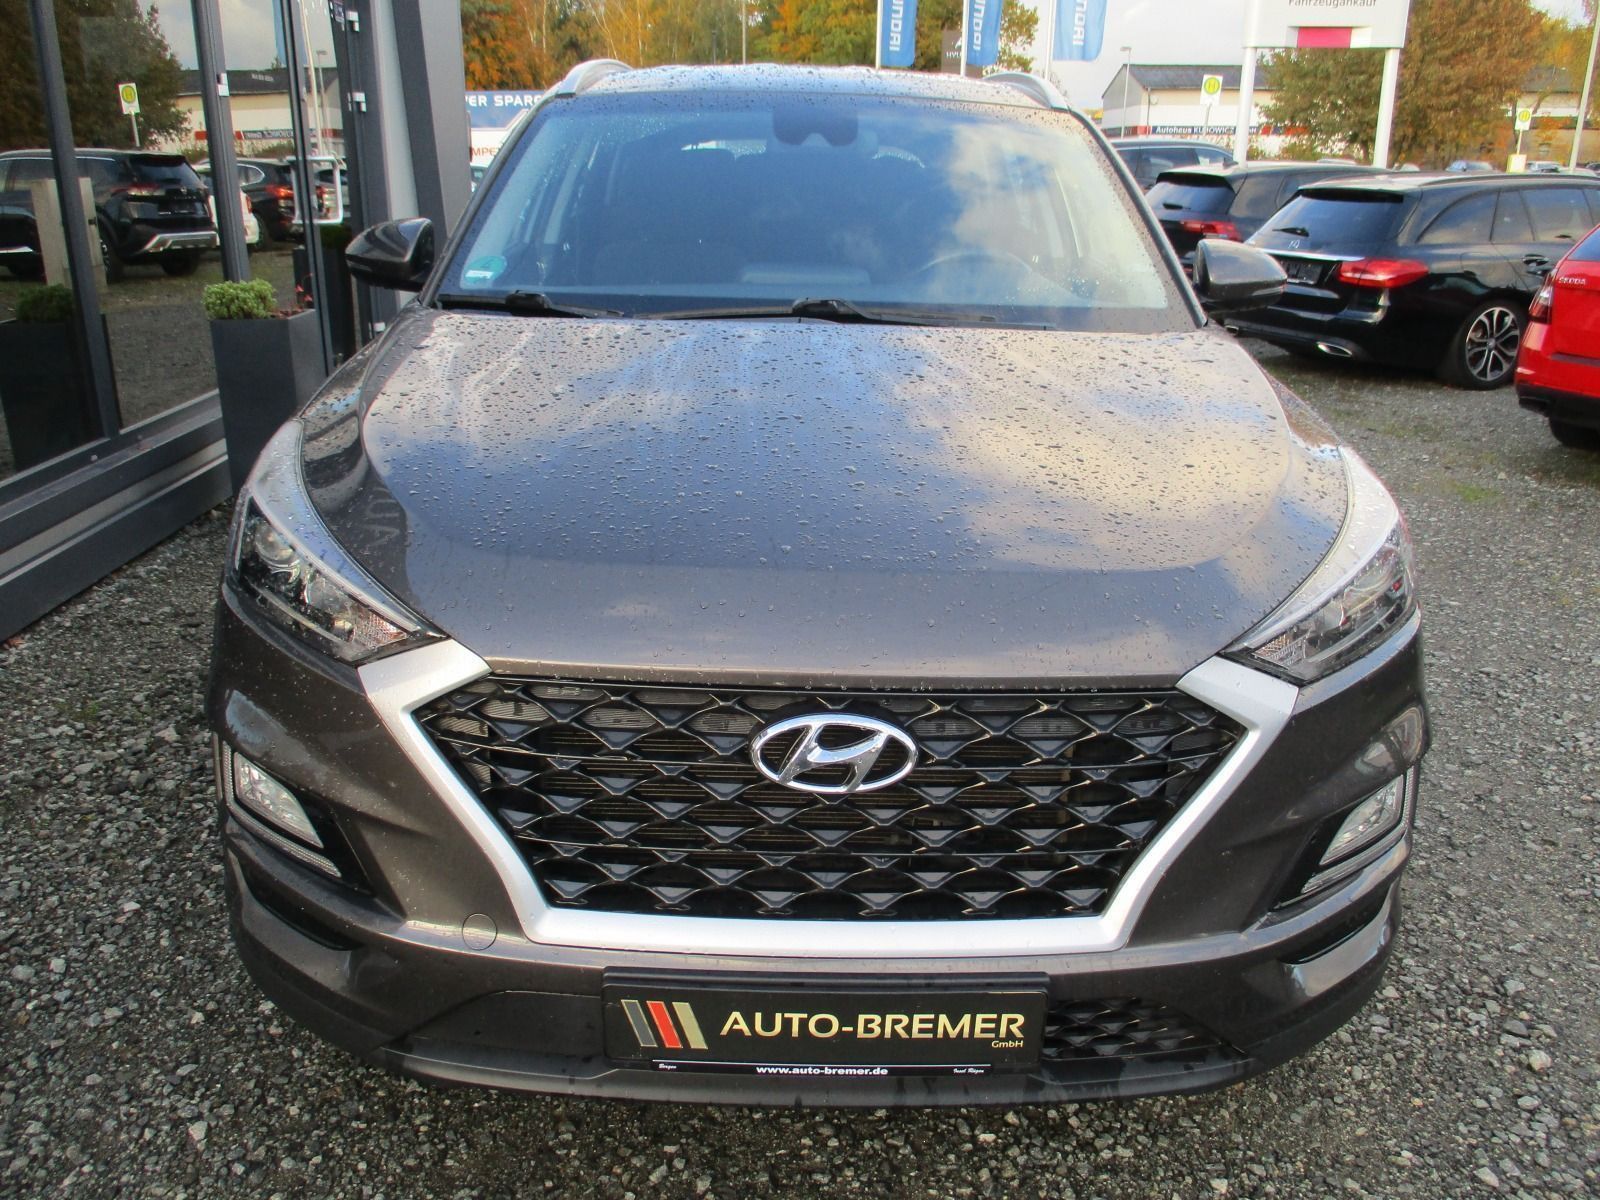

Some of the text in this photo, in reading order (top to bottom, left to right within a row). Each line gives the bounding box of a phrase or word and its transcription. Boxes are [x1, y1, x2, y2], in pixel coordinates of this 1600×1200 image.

[1156, 126, 1192, 134] Autohaus
[719, 1011, 1026, 1040] AUTO-BREMER
[991, 1040, 1024, 1049] GmbH
[755, 1065, 889, 1076] www.auto-bremer.de
